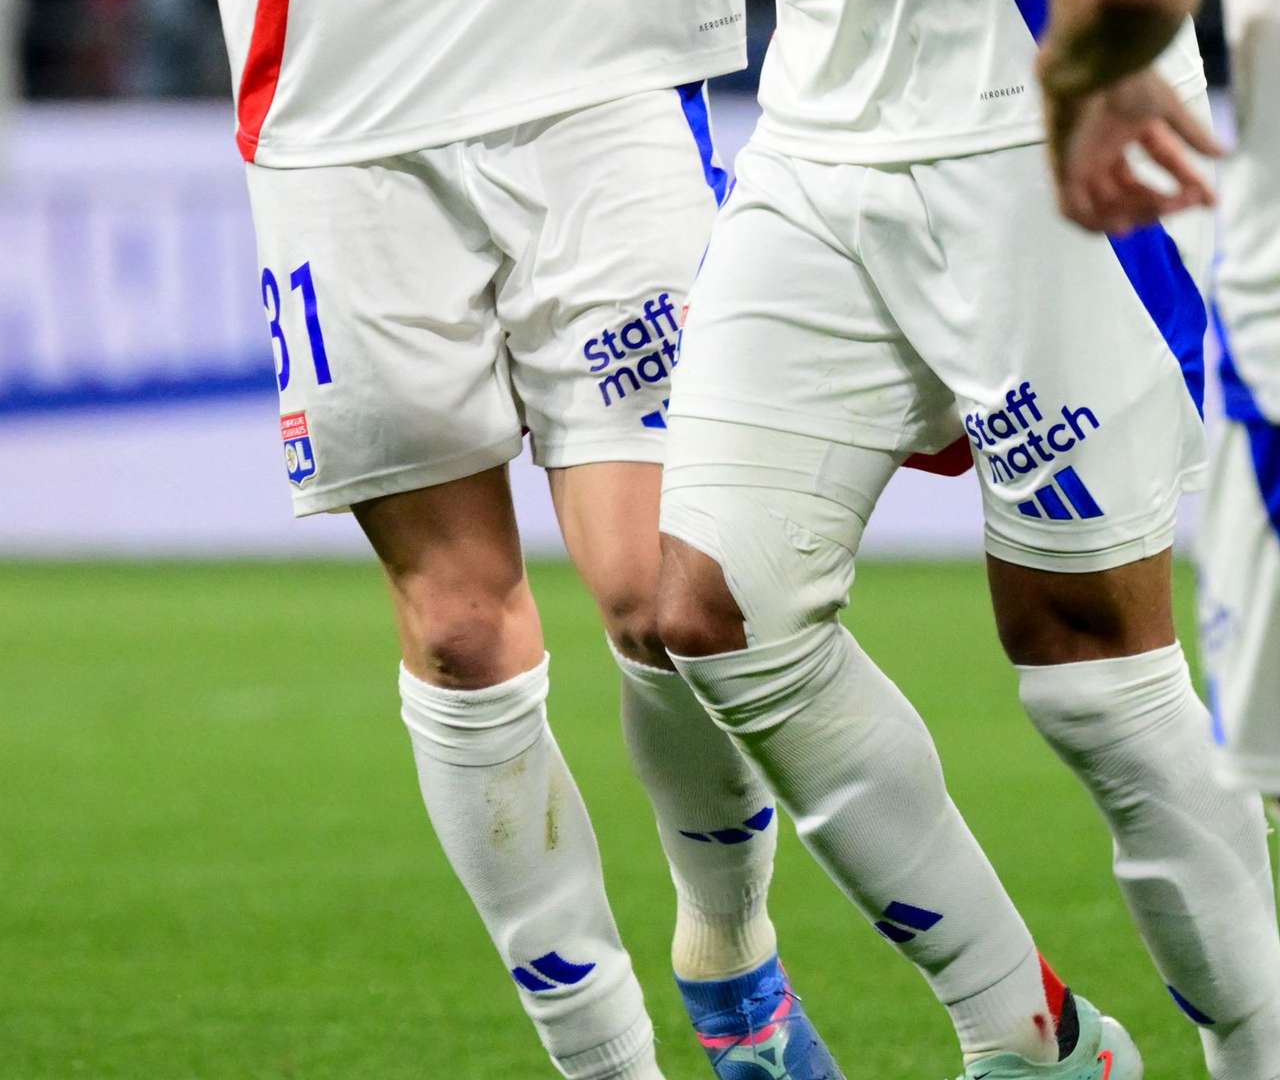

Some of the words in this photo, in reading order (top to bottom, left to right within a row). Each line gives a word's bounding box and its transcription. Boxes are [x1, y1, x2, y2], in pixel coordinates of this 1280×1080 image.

[262, 261, 332, 392] 31
[583, 292, 679, 372] Staff
[598, 339, 677, 407] mat
[965, 381, 1043, 450] Staff
[988, 405, 1100, 484] match
